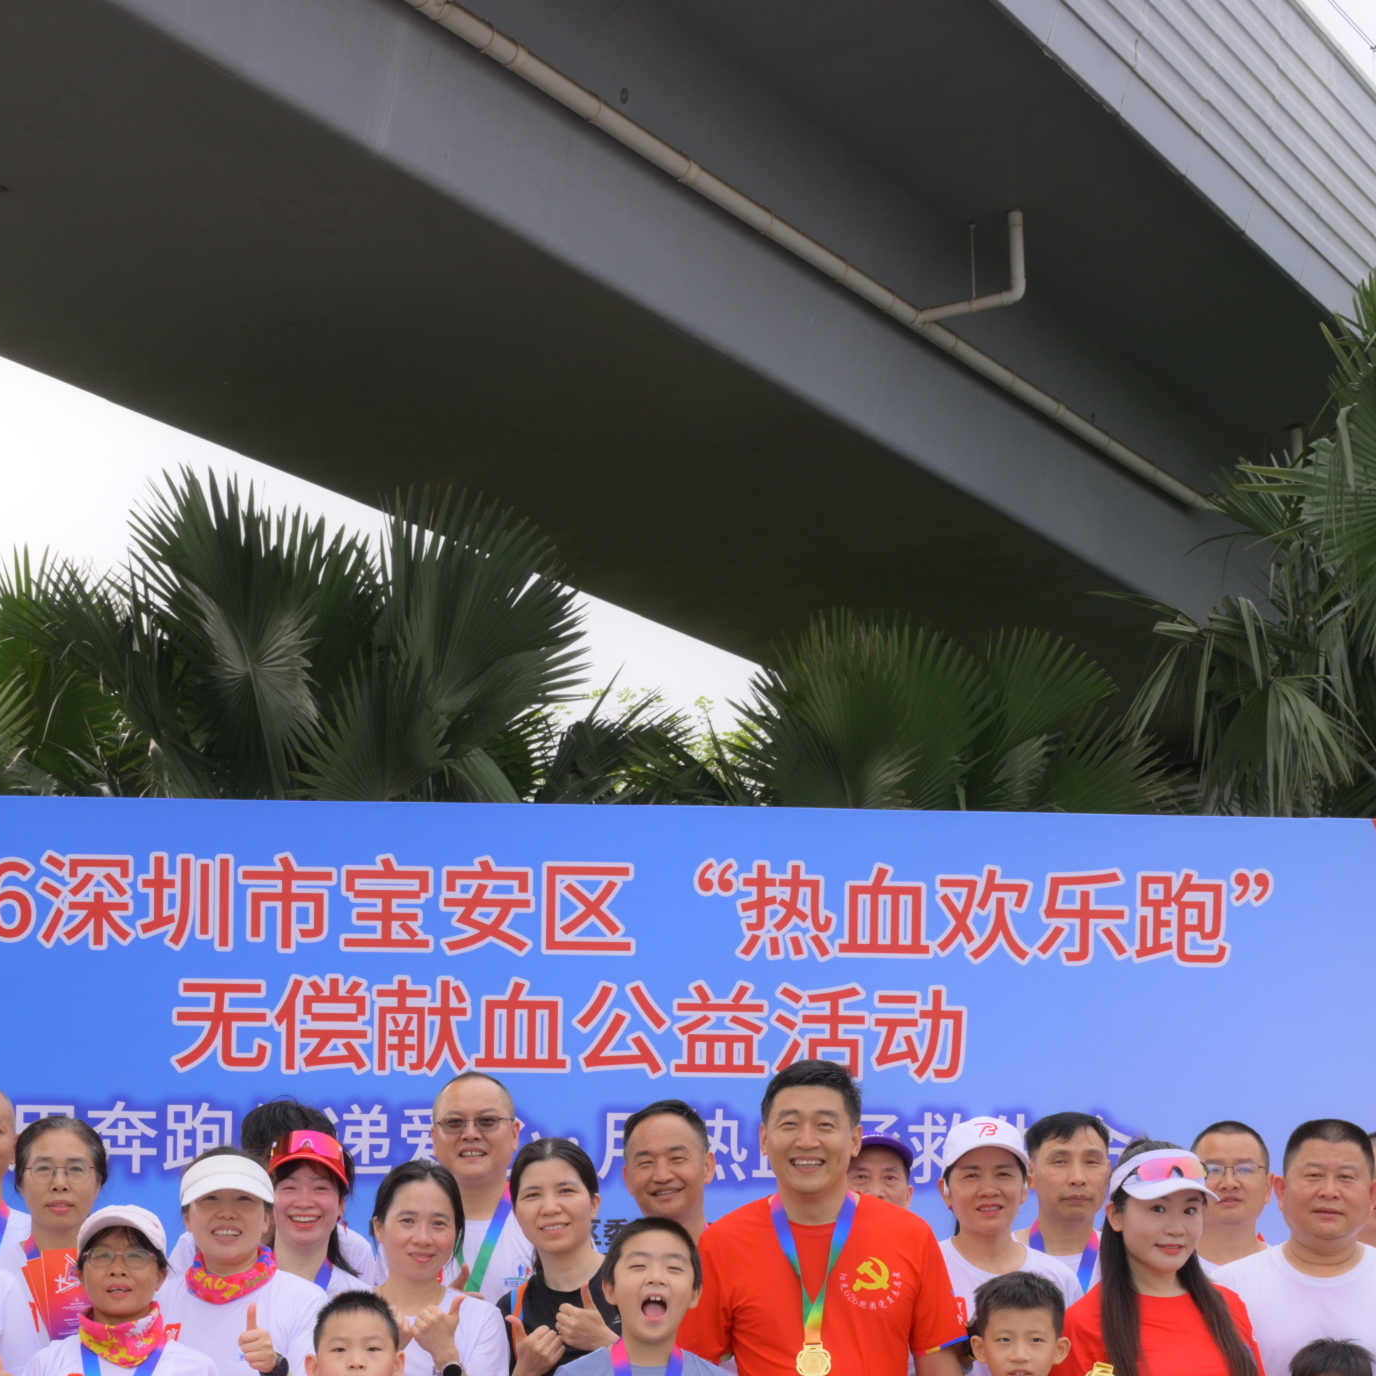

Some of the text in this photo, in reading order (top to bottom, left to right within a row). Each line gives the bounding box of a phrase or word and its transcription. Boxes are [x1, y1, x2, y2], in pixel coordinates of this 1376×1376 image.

[696, 860, 1273, 966] “热血欢乐跑”
[173, 975, 966, 1082] 无偿献血公益活动
